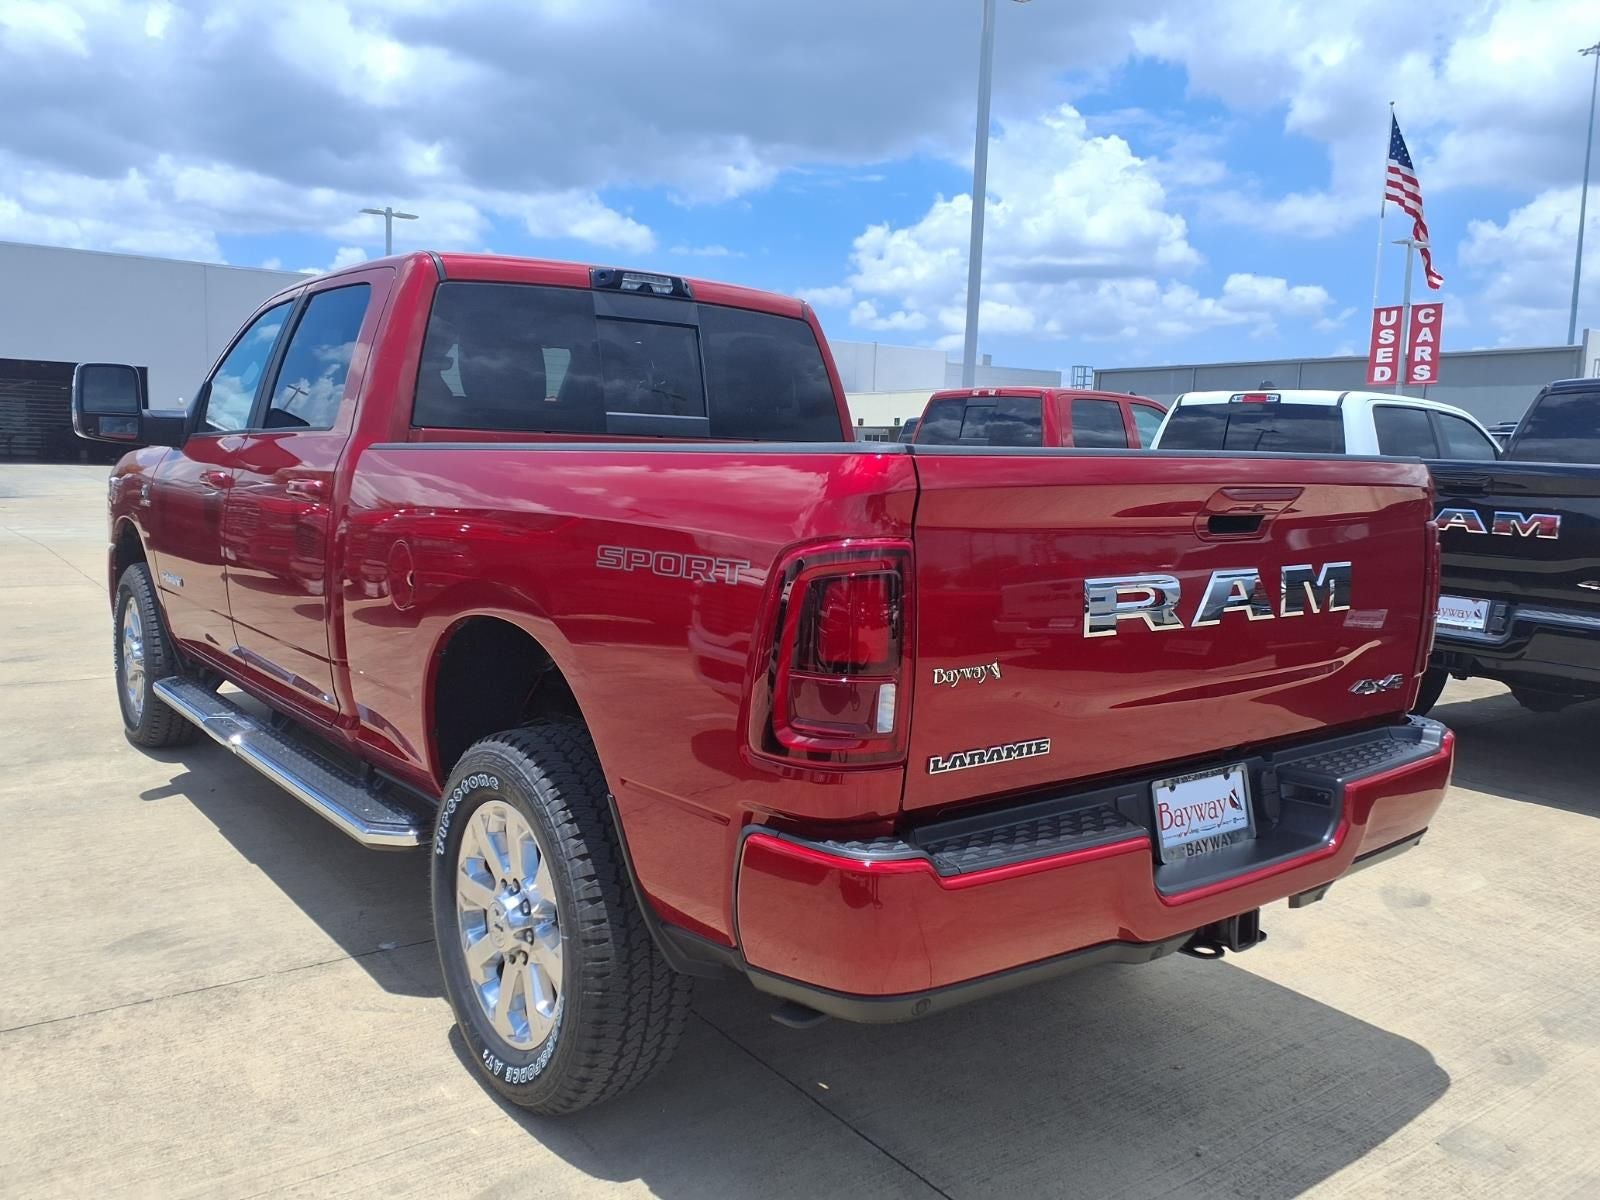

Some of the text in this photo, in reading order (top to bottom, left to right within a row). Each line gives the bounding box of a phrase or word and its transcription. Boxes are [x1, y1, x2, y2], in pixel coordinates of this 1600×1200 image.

[1373, 309, 1398, 382] USED
[1412, 307, 1437, 381] CARS
[1434, 507, 1562, 540] AM
[596, 544, 751, 585] SPORT
[1083, 560, 1352, 638] RAM
[1435, 606, 1474, 620] ayway
[933, 663, 991, 688] Bayway
[929, 738, 1051, 775] LARAMIE
[435, 773, 499, 856] Firestone
[1157, 797, 1227, 837] Bayway
[1186, 831, 1234, 857] BAYWAY
